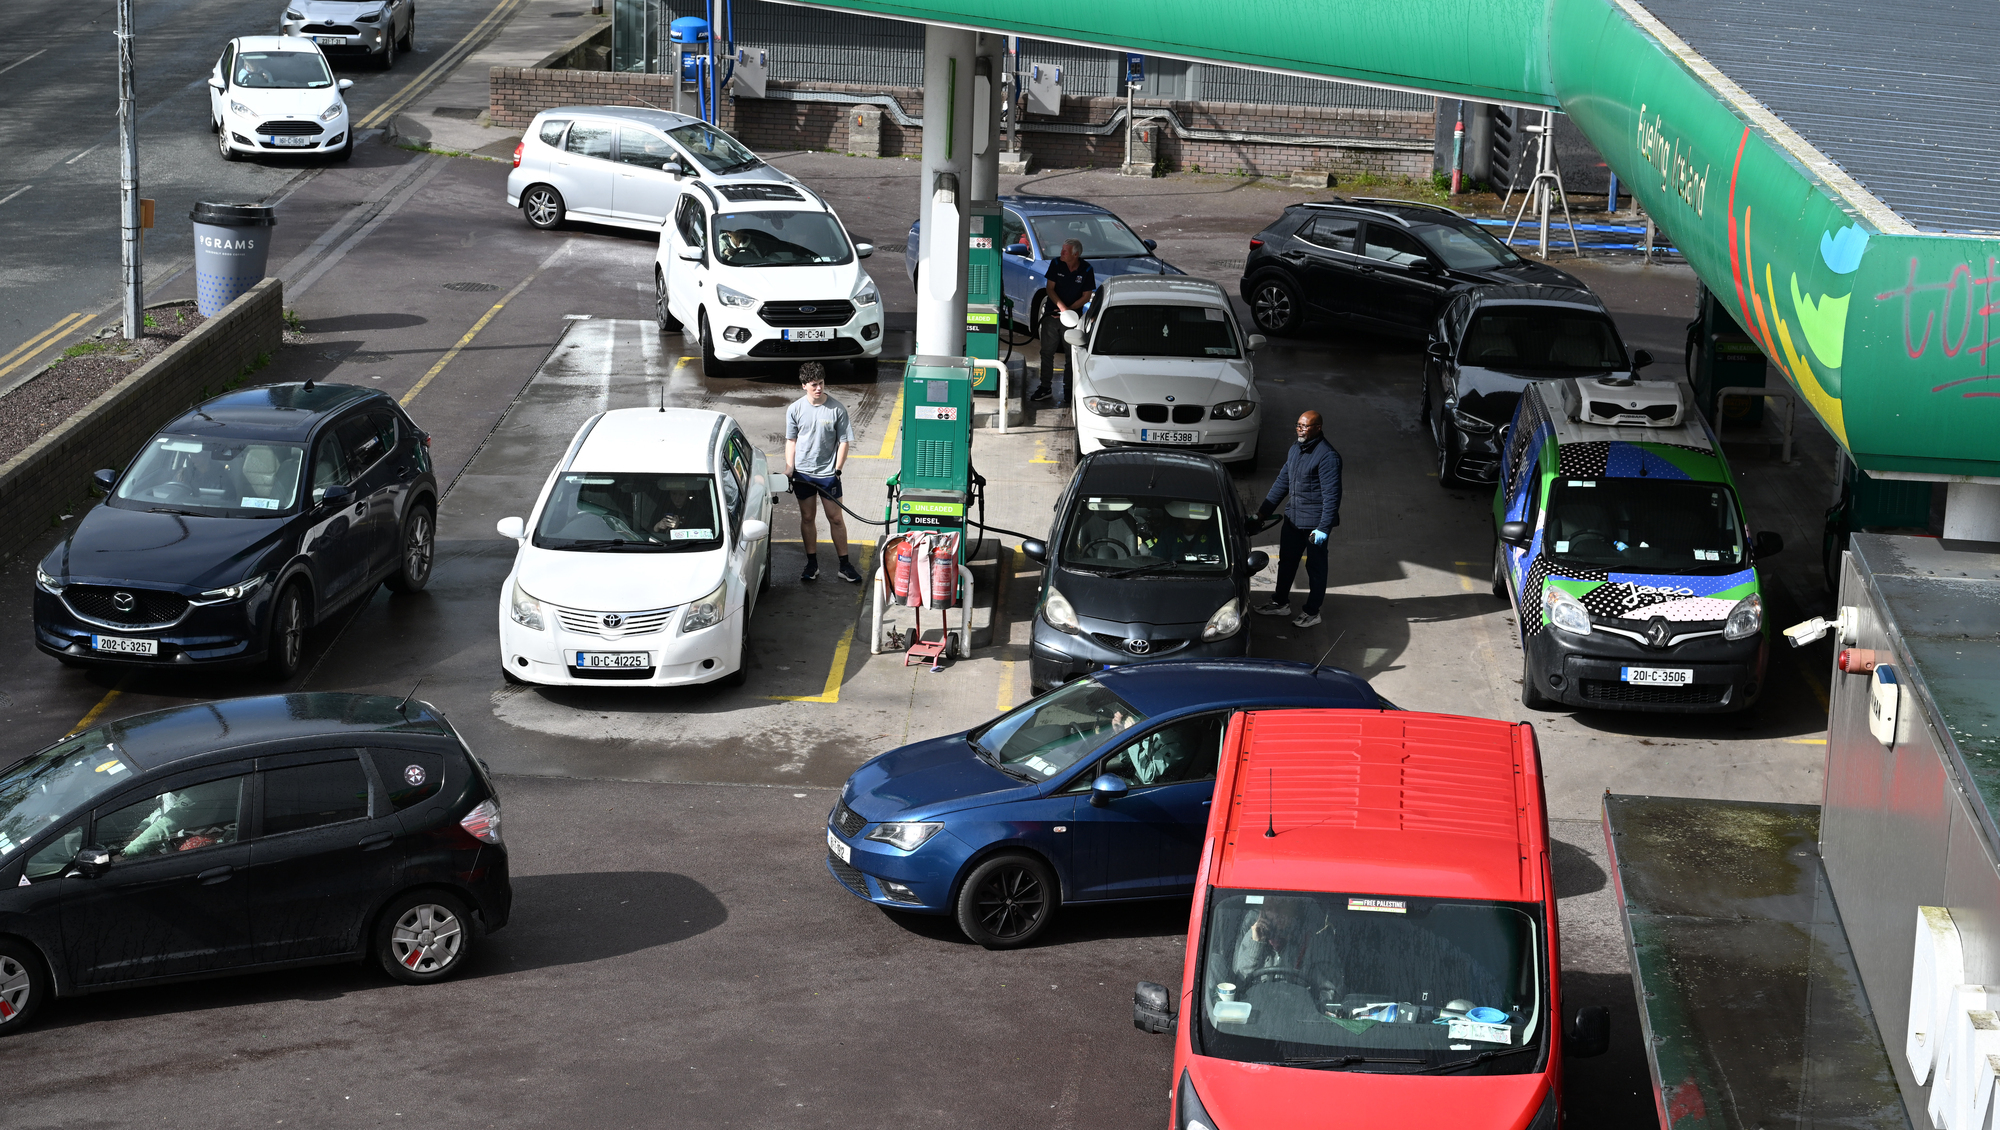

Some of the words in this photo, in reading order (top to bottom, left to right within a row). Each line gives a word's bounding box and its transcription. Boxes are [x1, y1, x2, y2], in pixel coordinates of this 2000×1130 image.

[1637, 103, 1671, 193] Fueling
[1671, 137, 1710, 221] Ireland
[797, 331, 825, 339] 181-C-341
[1153, 431, 1193, 442] 11-KE-5388
[915, 504, 954, 513] UNLEADED
[915, 517, 940, 525] DIESEL
[1617, 581, 1694, 607] Joe's
[101, 638, 152, 652] 202-C-3257
[591, 655, 642, 667] 10-C-41225
[1633, 670, 1686, 682] 201-C-3506
